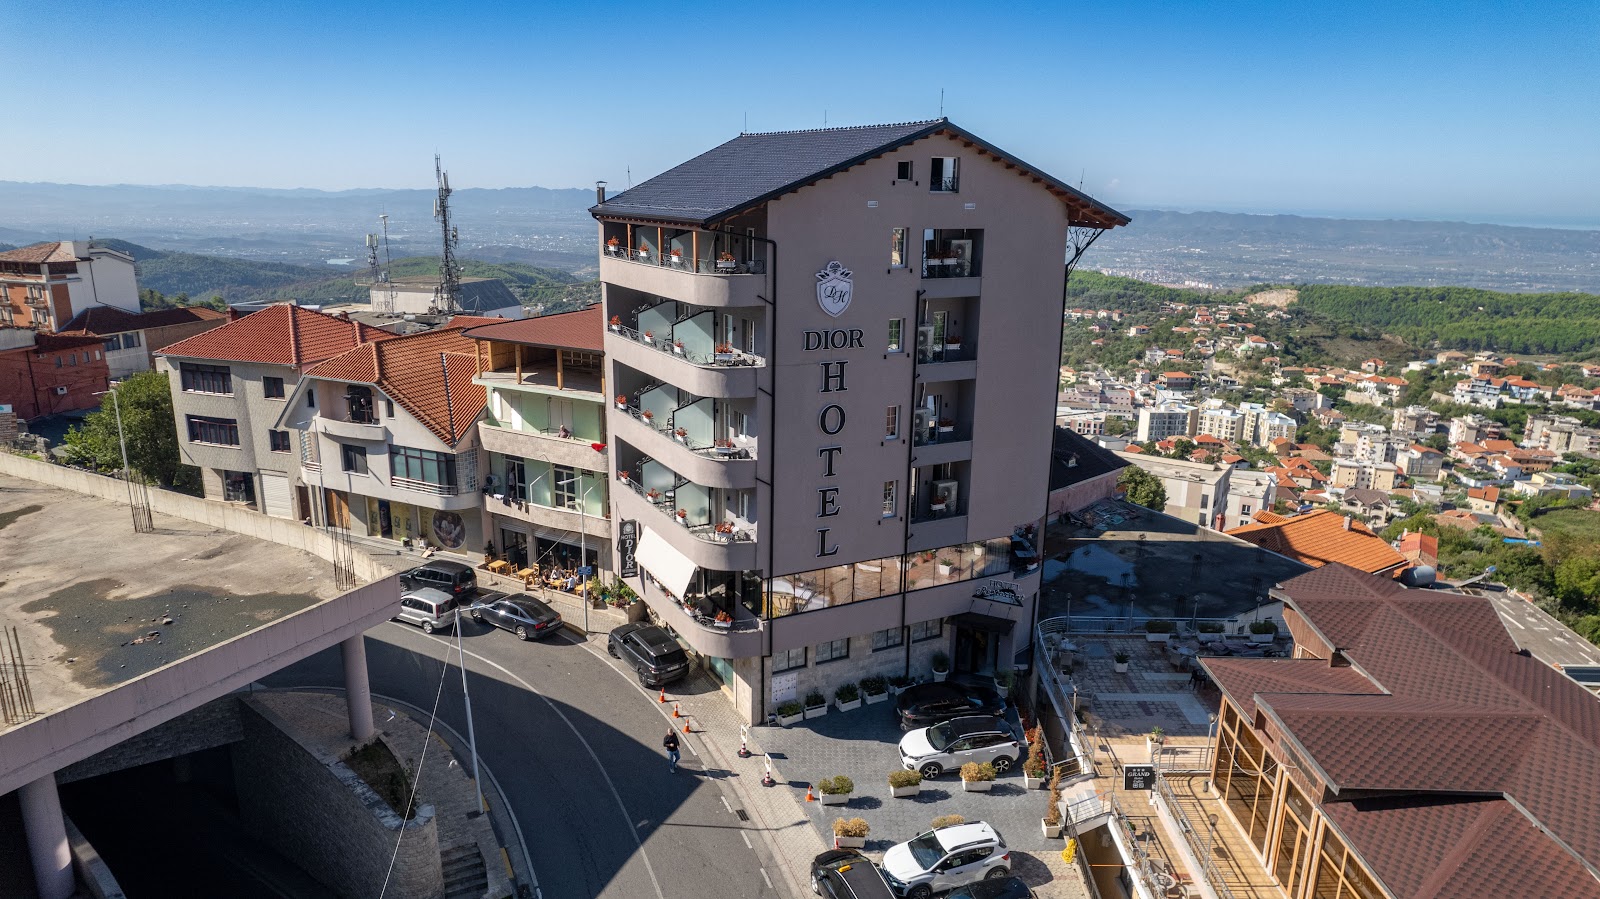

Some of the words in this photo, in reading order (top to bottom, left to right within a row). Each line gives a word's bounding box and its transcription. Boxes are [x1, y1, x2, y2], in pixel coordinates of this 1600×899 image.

[803, 328, 865, 352] DIOR
[815, 360, 849, 558] HOTEL
[625, 540, 634, 569] DIOR
[989, 579, 1023, 591] HOTEL
